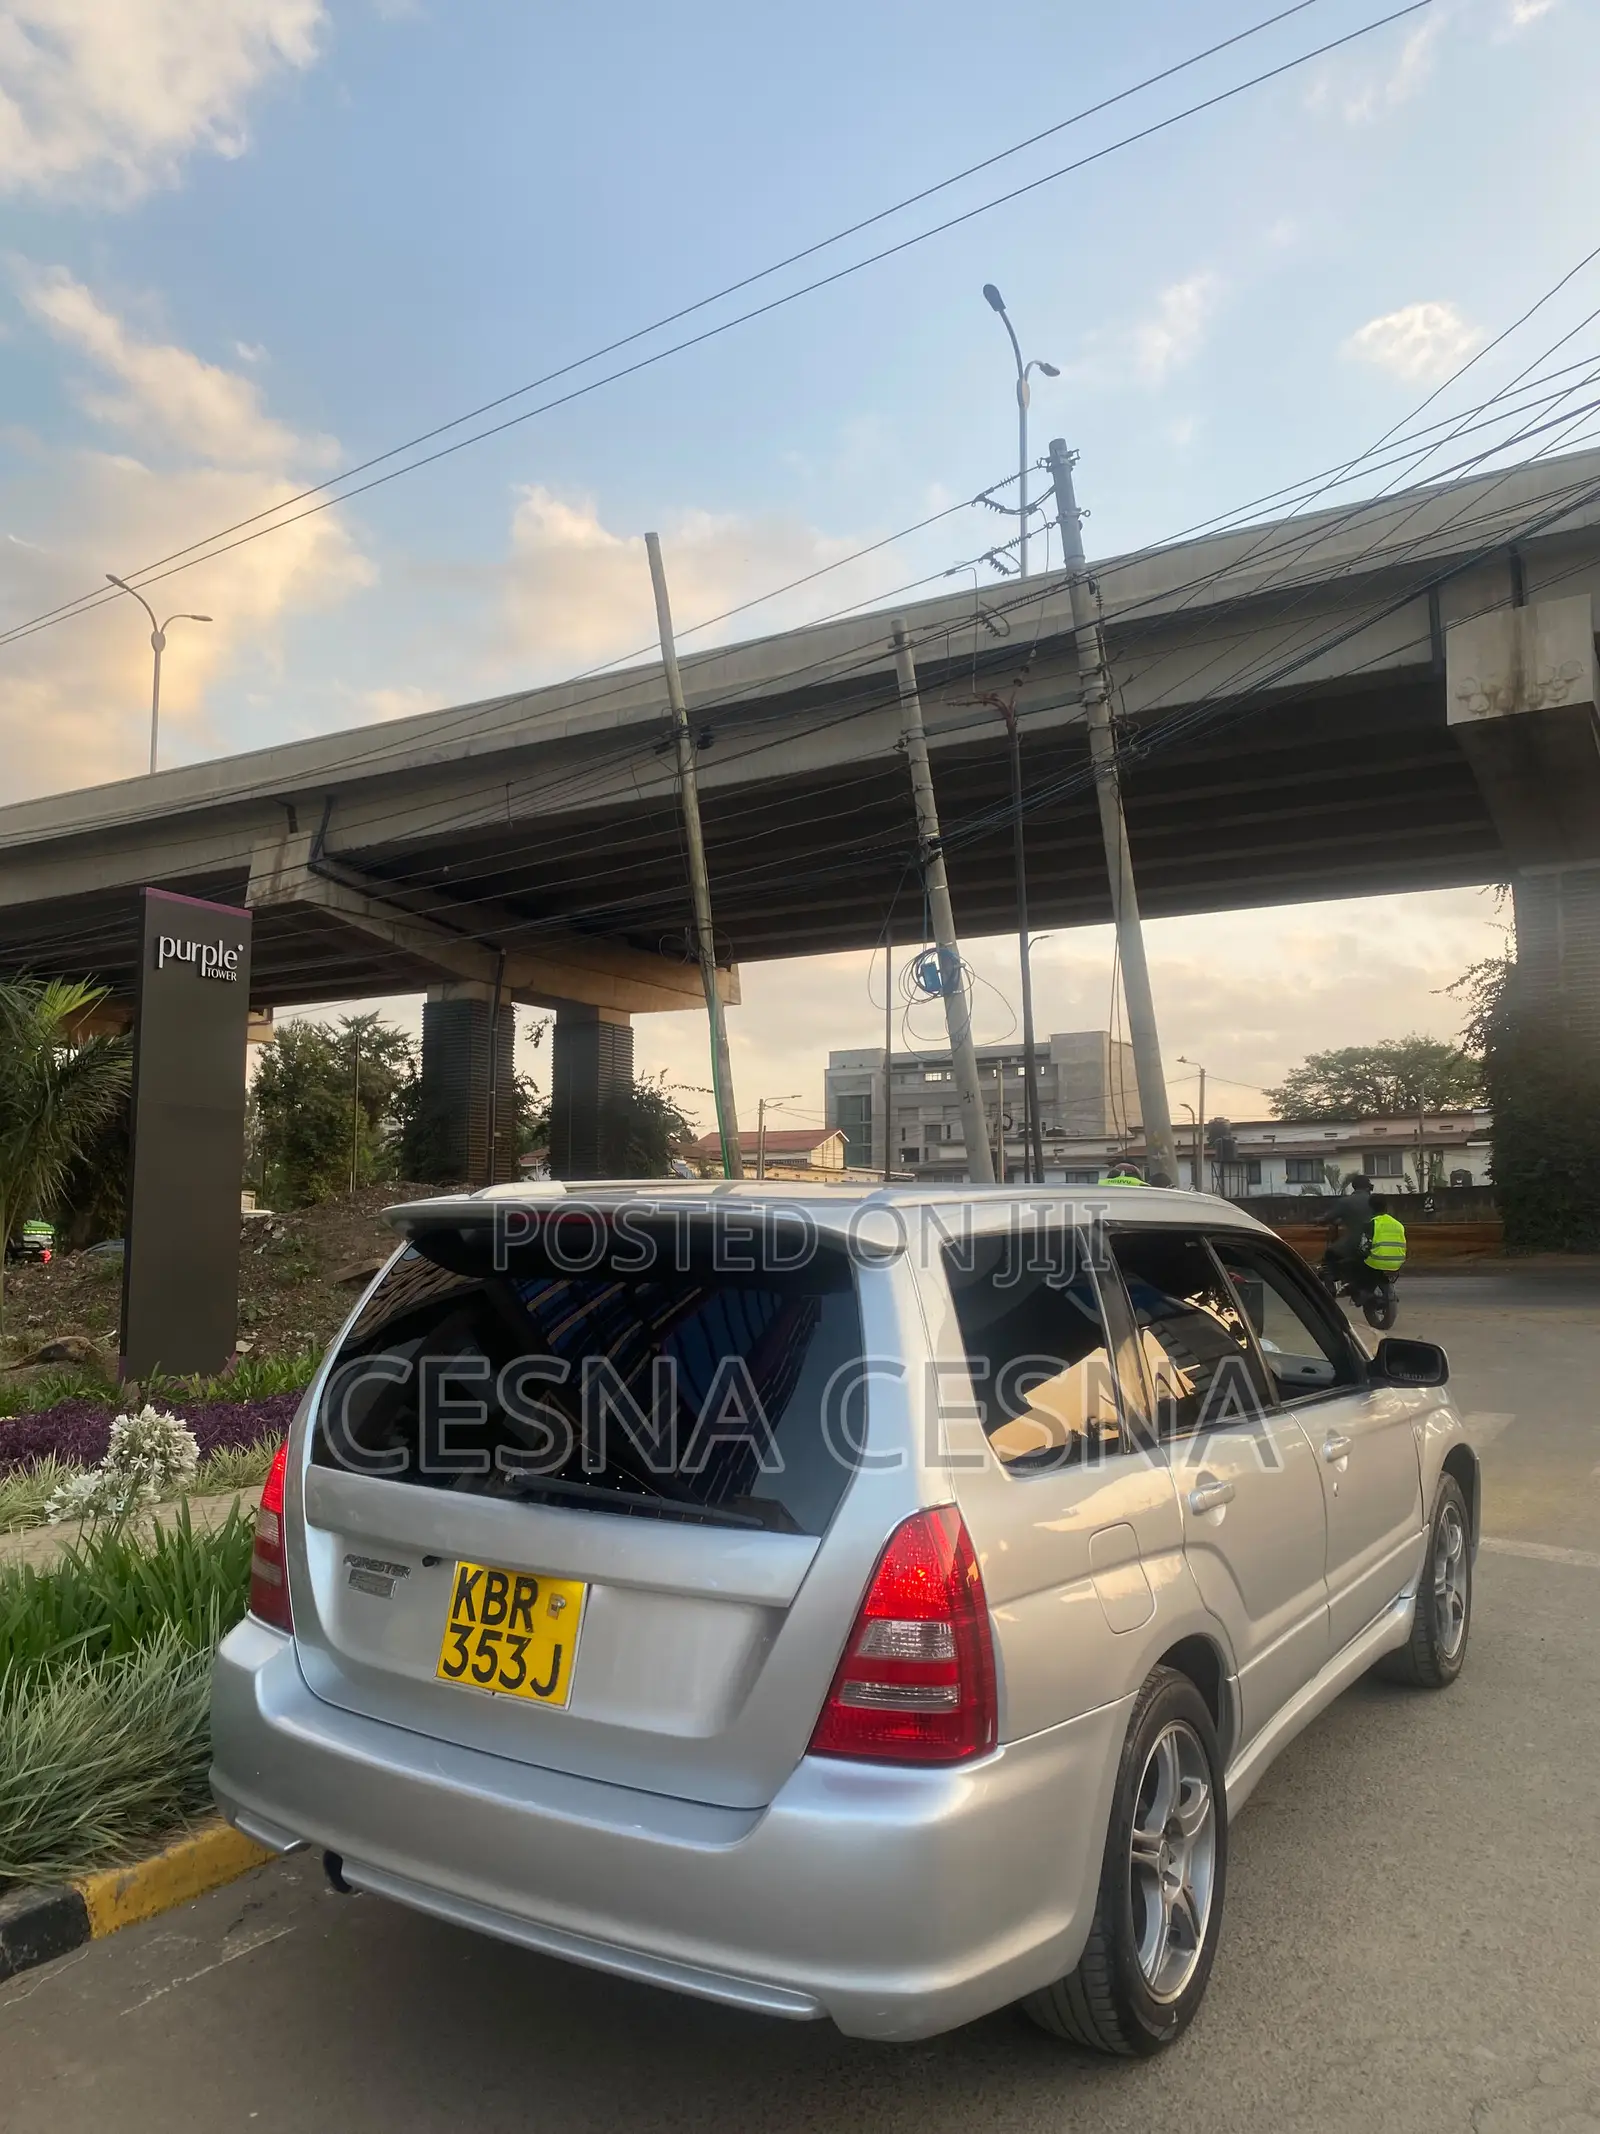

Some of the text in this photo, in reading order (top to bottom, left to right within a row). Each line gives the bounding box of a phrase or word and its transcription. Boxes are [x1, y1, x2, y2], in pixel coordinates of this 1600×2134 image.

[158, 935, 238, 977] purple
[207, 967, 237, 981] TOWER
[452, 1566, 538, 1633] KBR
[442, 1622, 563, 1698] 353J
